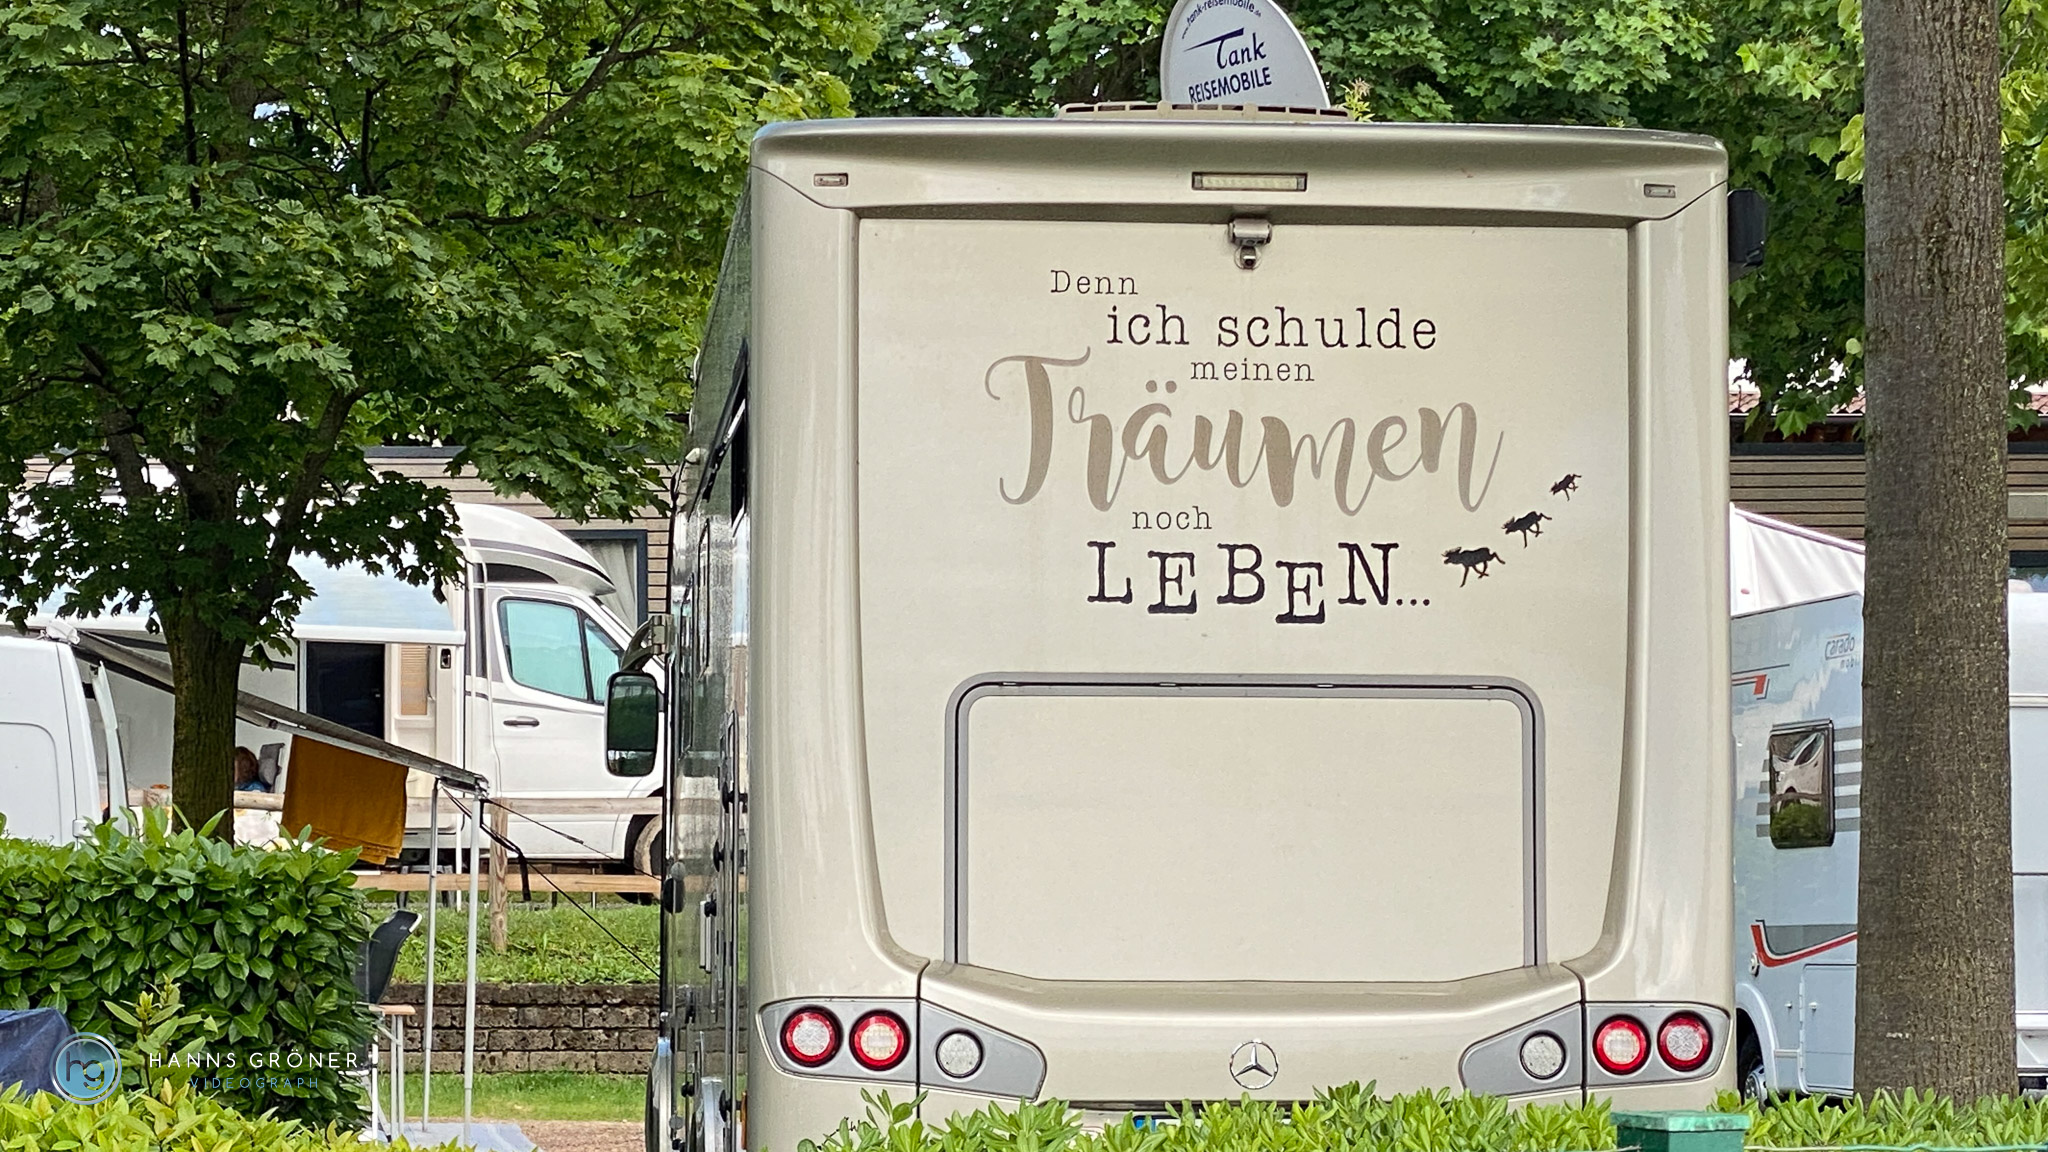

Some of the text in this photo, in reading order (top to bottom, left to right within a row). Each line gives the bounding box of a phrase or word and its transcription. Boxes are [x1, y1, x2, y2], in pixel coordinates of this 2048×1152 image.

[1184, 27, 1267, 70] Tank
[1188, 66, 1272, 103] REISEMOBILE
[1050, 269, 1139, 295] Denn
[1106, 304, 1437, 350] ich schulde
[1190, 358, 1315, 382] meinen
[985, 346, 1504, 516] Träumen
[1131, 505, 1213, 531] noch
[1086, 540, 1431, 625] LEBEN...
[1825, 634, 1855, 660] carado
